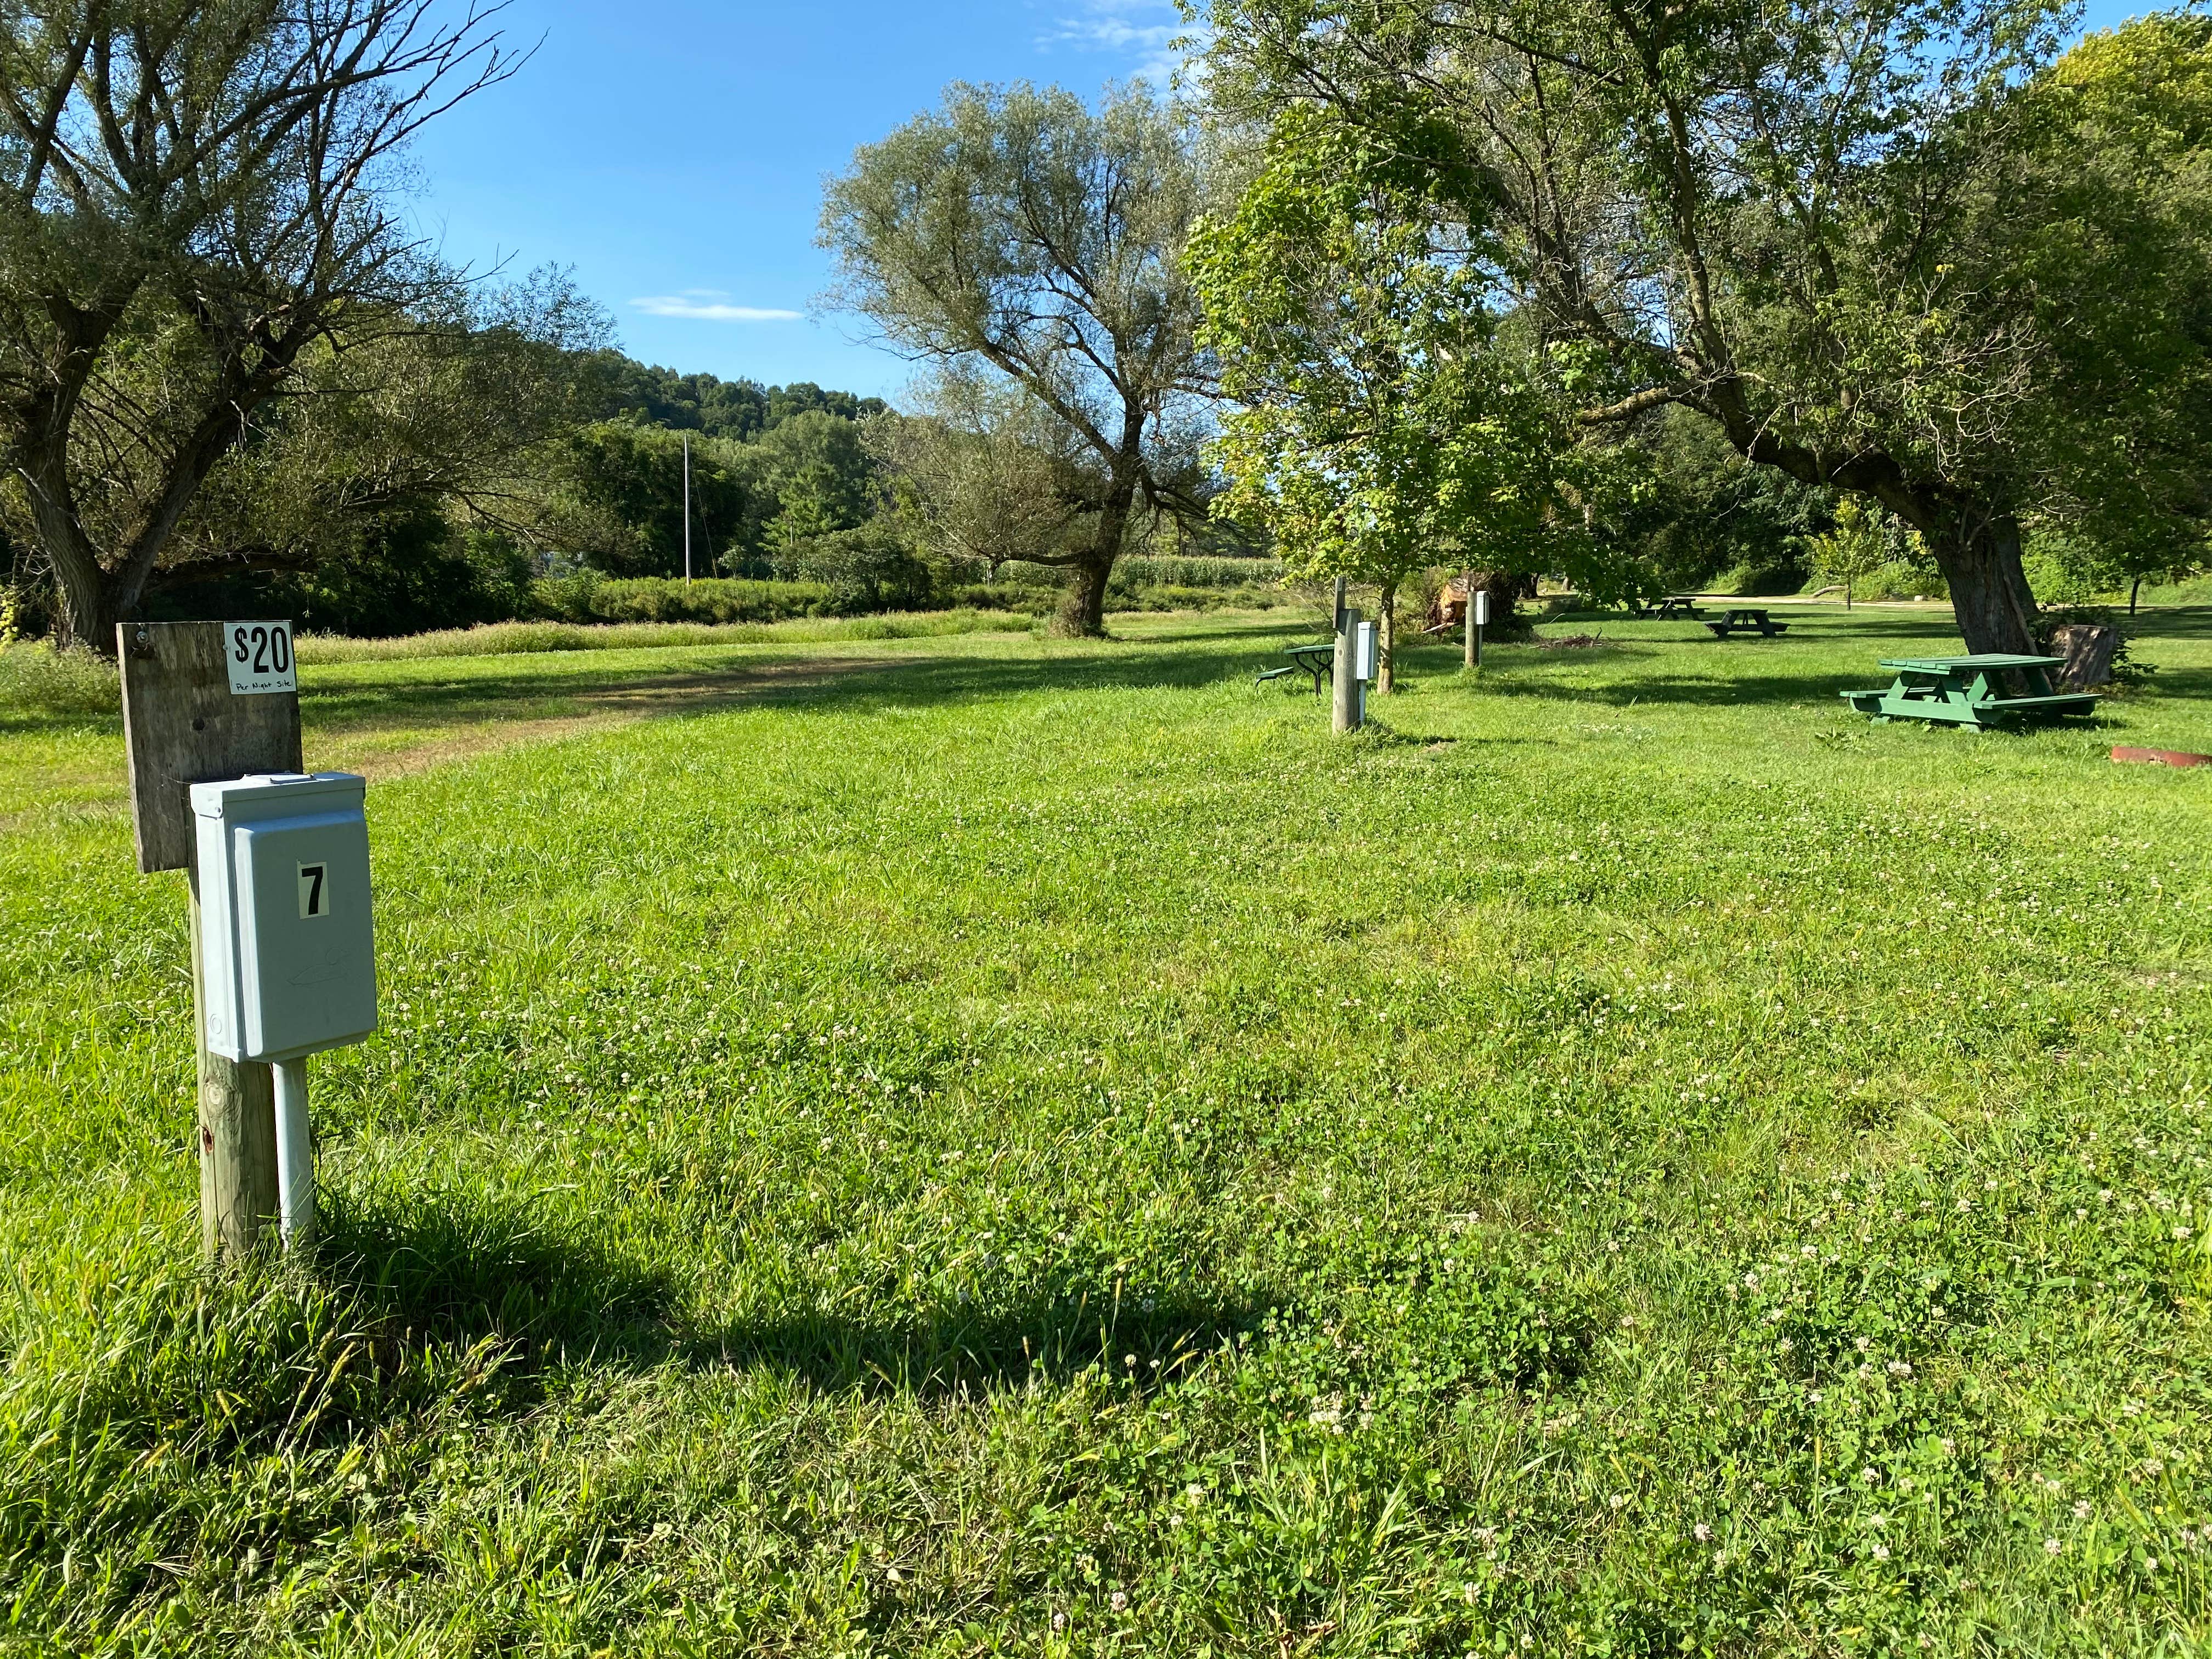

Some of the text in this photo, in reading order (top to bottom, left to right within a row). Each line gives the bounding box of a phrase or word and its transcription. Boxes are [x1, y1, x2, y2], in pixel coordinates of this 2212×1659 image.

[234, 626, 289, 673] $20
[252, 682, 272, 690] Night
[276, 679, 291, 687] Site
[301, 866, 323, 916] 7
